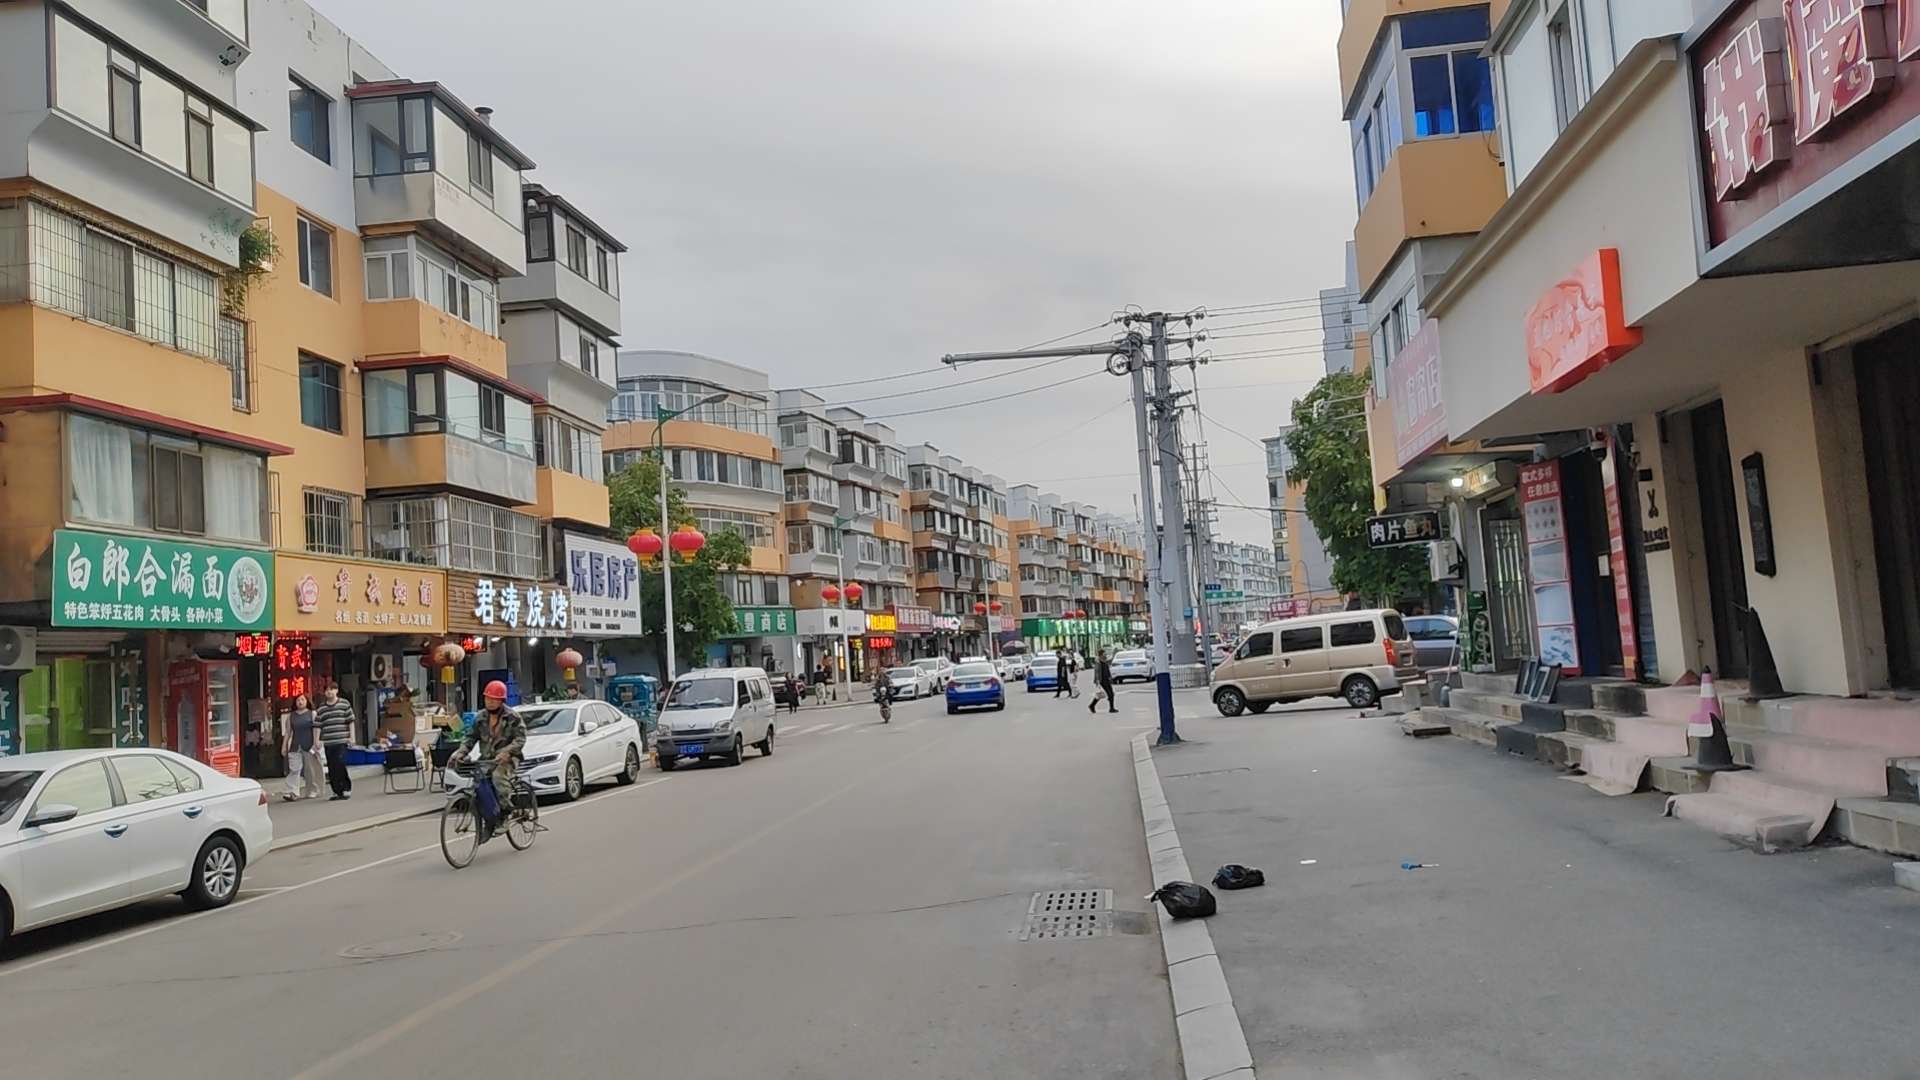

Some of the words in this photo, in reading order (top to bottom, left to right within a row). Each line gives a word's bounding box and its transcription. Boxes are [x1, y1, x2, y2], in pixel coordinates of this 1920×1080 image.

[1370, 517, 1435, 543] 肉片鱼丸
[66, 539, 224, 601] 白郎合漏面
[571, 549, 637, 600] 乐居房产
[150, 605, 181, 622] 大骨头
[186, 607, 224, 624] 各种小菜
[474, 578, 569, 629] 君涛烧烤
[374, 612, 395, 625] 土特产
[238, 635, 269, 655] 烟酒
